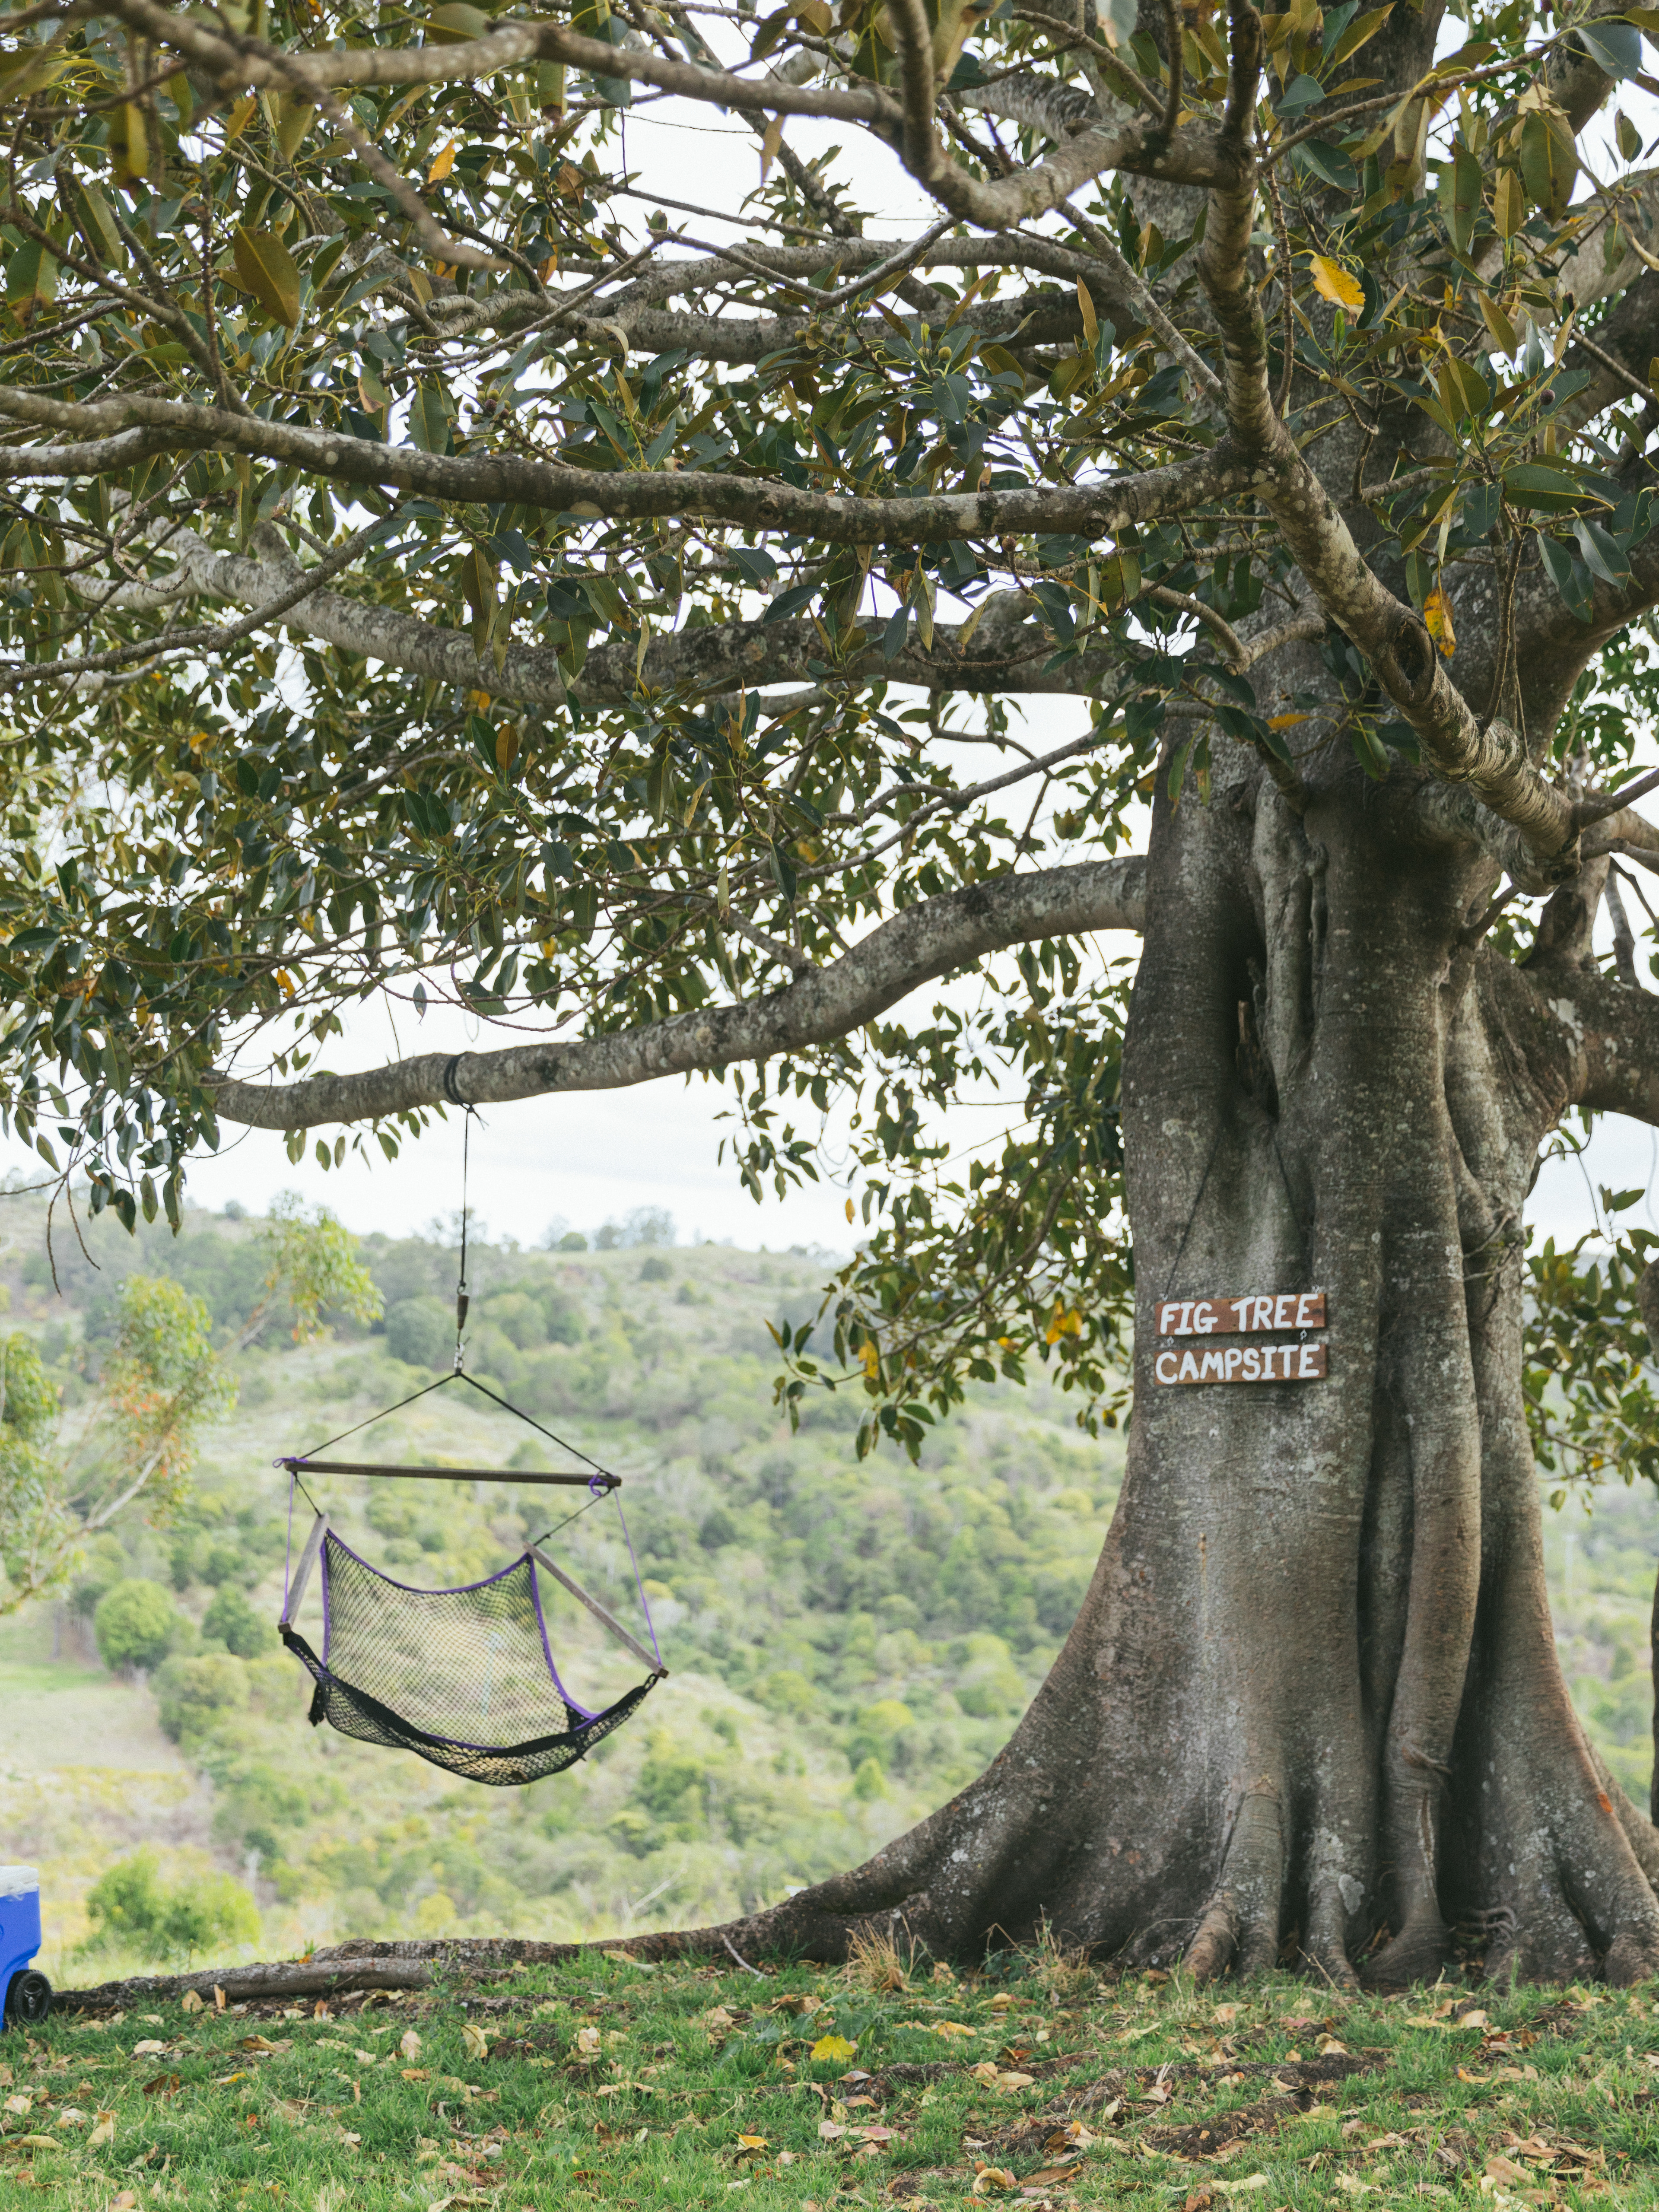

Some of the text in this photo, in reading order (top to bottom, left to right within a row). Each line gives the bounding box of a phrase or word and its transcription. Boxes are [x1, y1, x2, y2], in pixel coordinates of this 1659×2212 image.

[1160, 1293, 1318, 1335] FIG TREE
[1155, 1344, 1320, 1384] CAMPSITE
